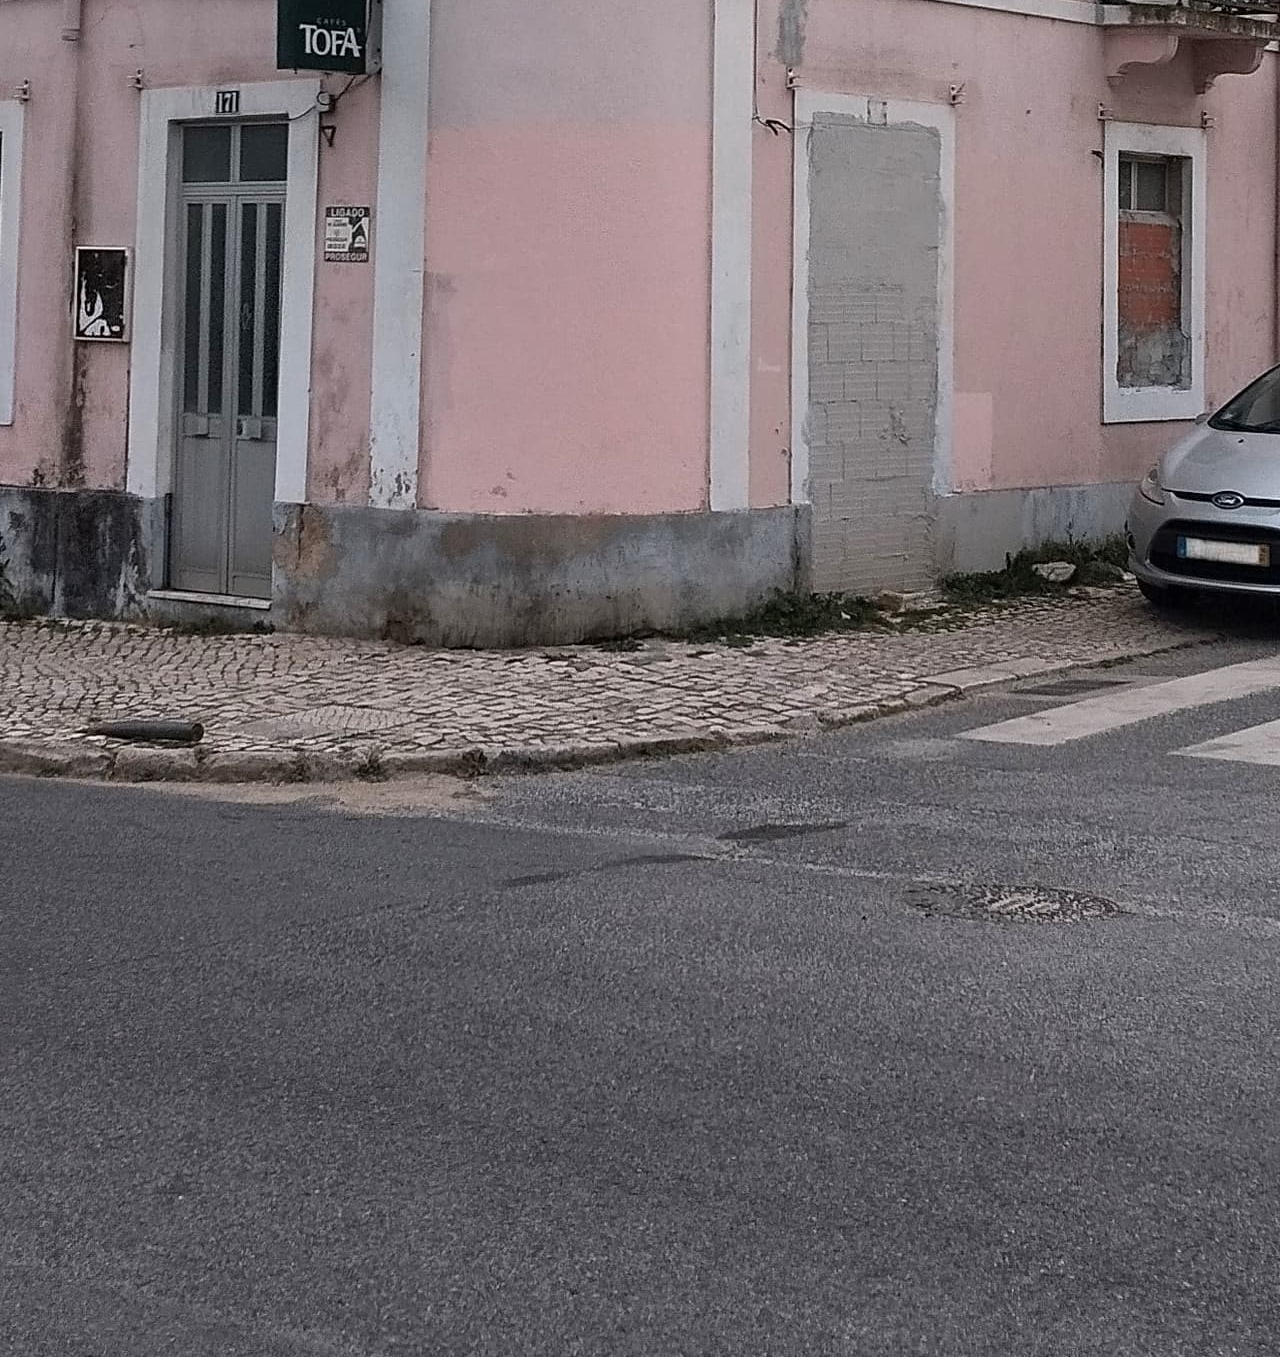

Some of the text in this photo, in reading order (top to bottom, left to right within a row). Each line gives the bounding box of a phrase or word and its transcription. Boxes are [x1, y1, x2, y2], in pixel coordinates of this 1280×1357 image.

[299, 24, 362, 57] TOFA
[219, 92, 237, 112] 171
[331, 208, 365, 217] LIGADO
[325, 252, 368, 261] PROSEGUR
